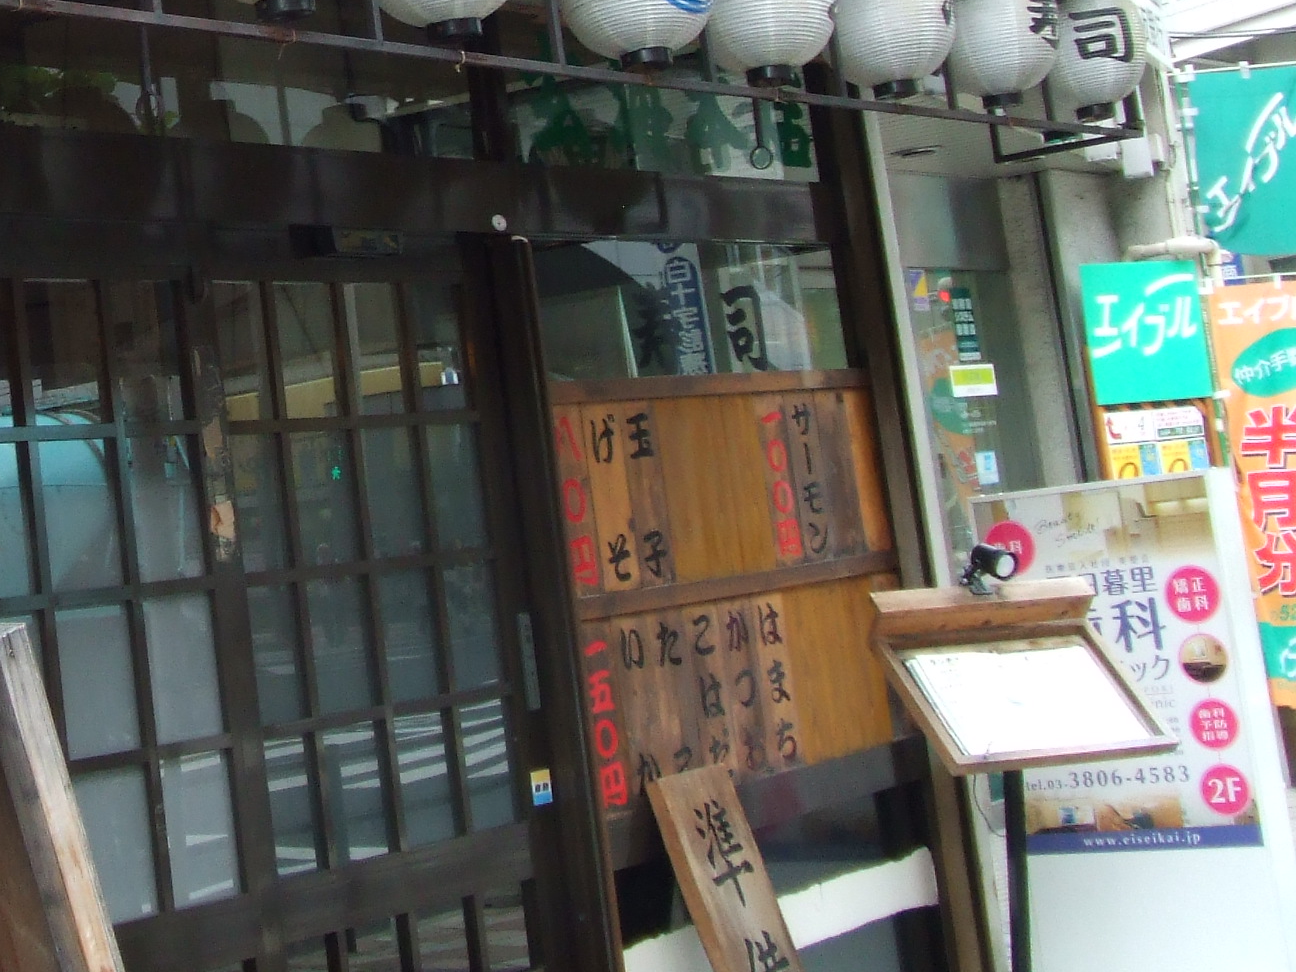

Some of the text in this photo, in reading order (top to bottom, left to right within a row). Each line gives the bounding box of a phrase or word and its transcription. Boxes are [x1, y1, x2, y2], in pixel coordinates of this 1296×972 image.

[1068, 7, 1135, 62] 司
[1092, 284, 1198, 357] エイブル
[1218, 295, 1296, 325] エイブ
[590, 414, 632, 582] げそ
[626, 412, 668, 577] 玉子
[791, 403, 828, 554] サーモン
[757, 602, 798, 760] はまち
[1131, 655, 1172, 682] ック
[1207, 776, 1242, 804] 2F
[1083, 831, 1202, 848] www.eiseikai.jp
